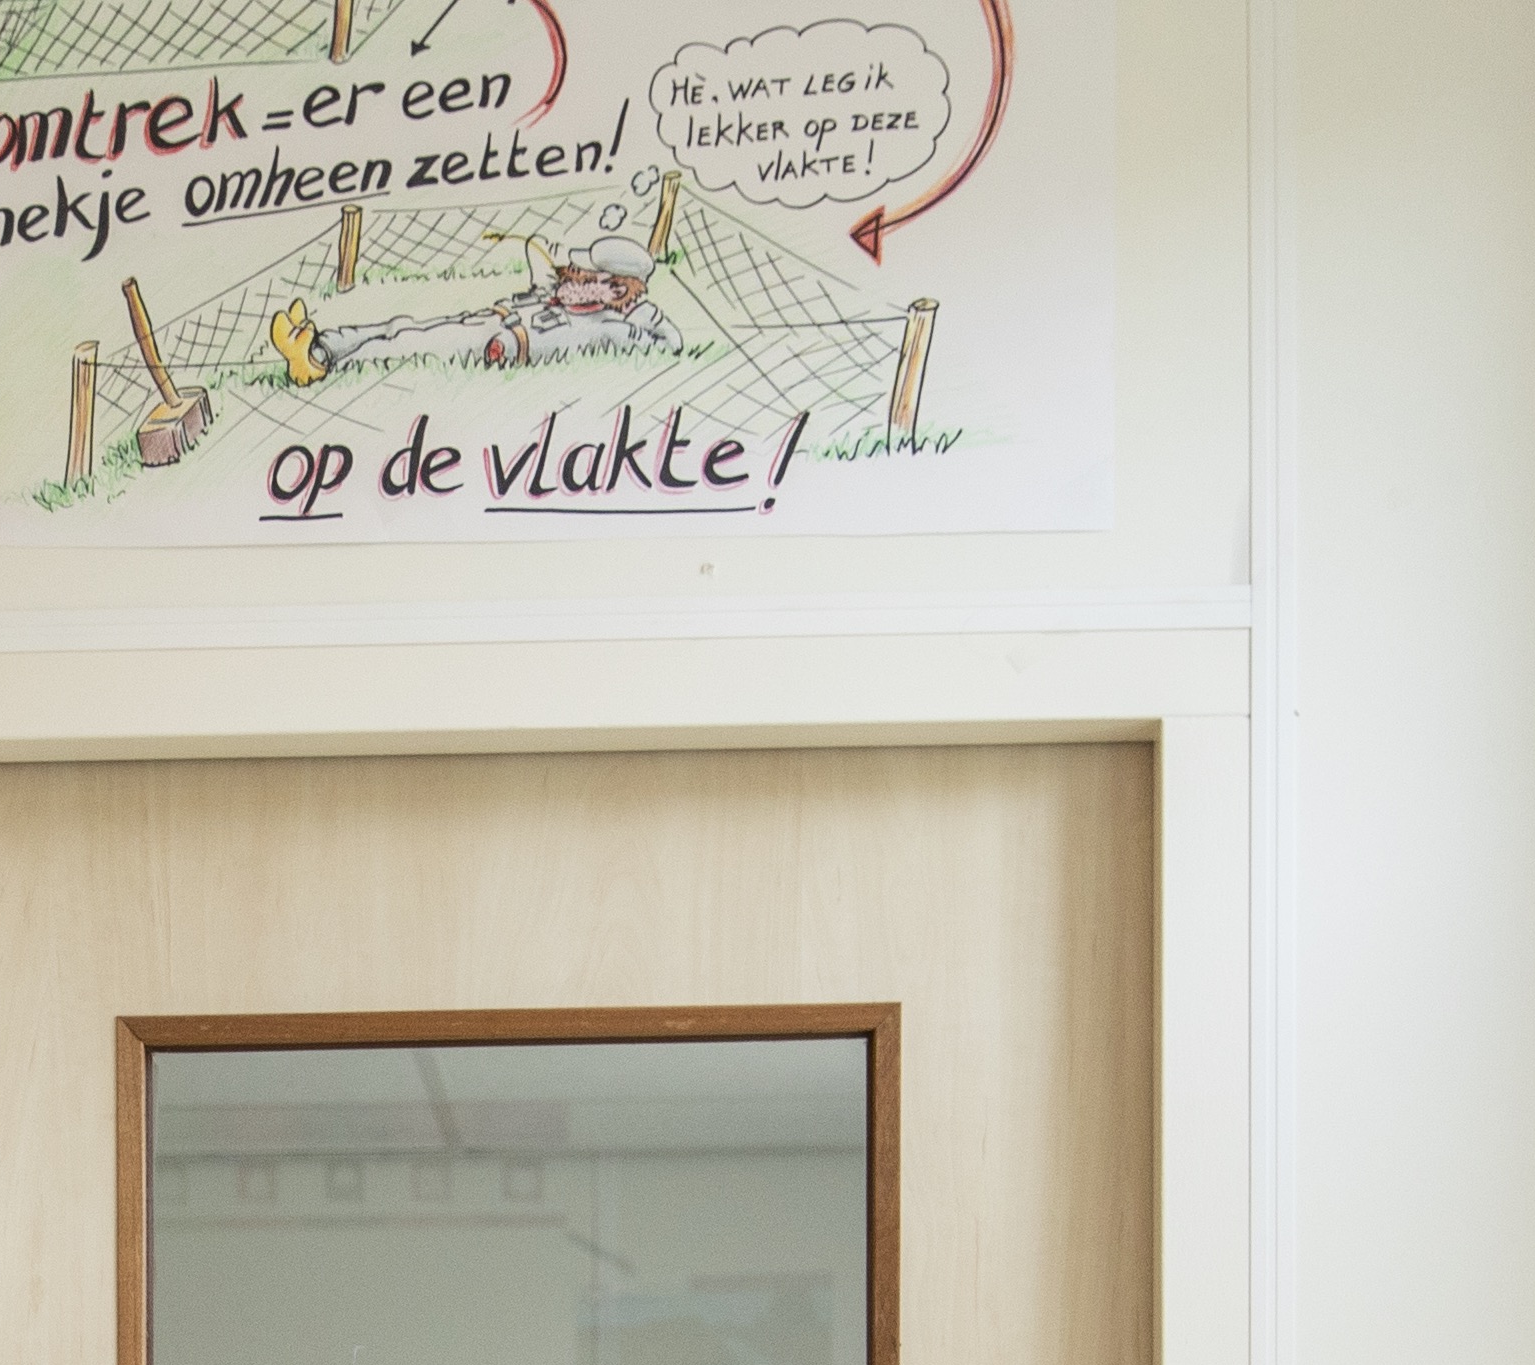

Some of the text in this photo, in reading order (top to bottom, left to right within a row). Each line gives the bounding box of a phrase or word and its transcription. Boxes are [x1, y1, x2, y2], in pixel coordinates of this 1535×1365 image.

[402, 72, 512, 118] een
[728, 77, 792, 101] WAT
[804, 72, 856, 95] LEG
[851, 110, 919, 132] DEZE
[184, 146, 391, 220] omheen
[405, 98, 630, 188] zetten!
[268, 443, 353, 515] op
[379, 413, 465, 496] de
